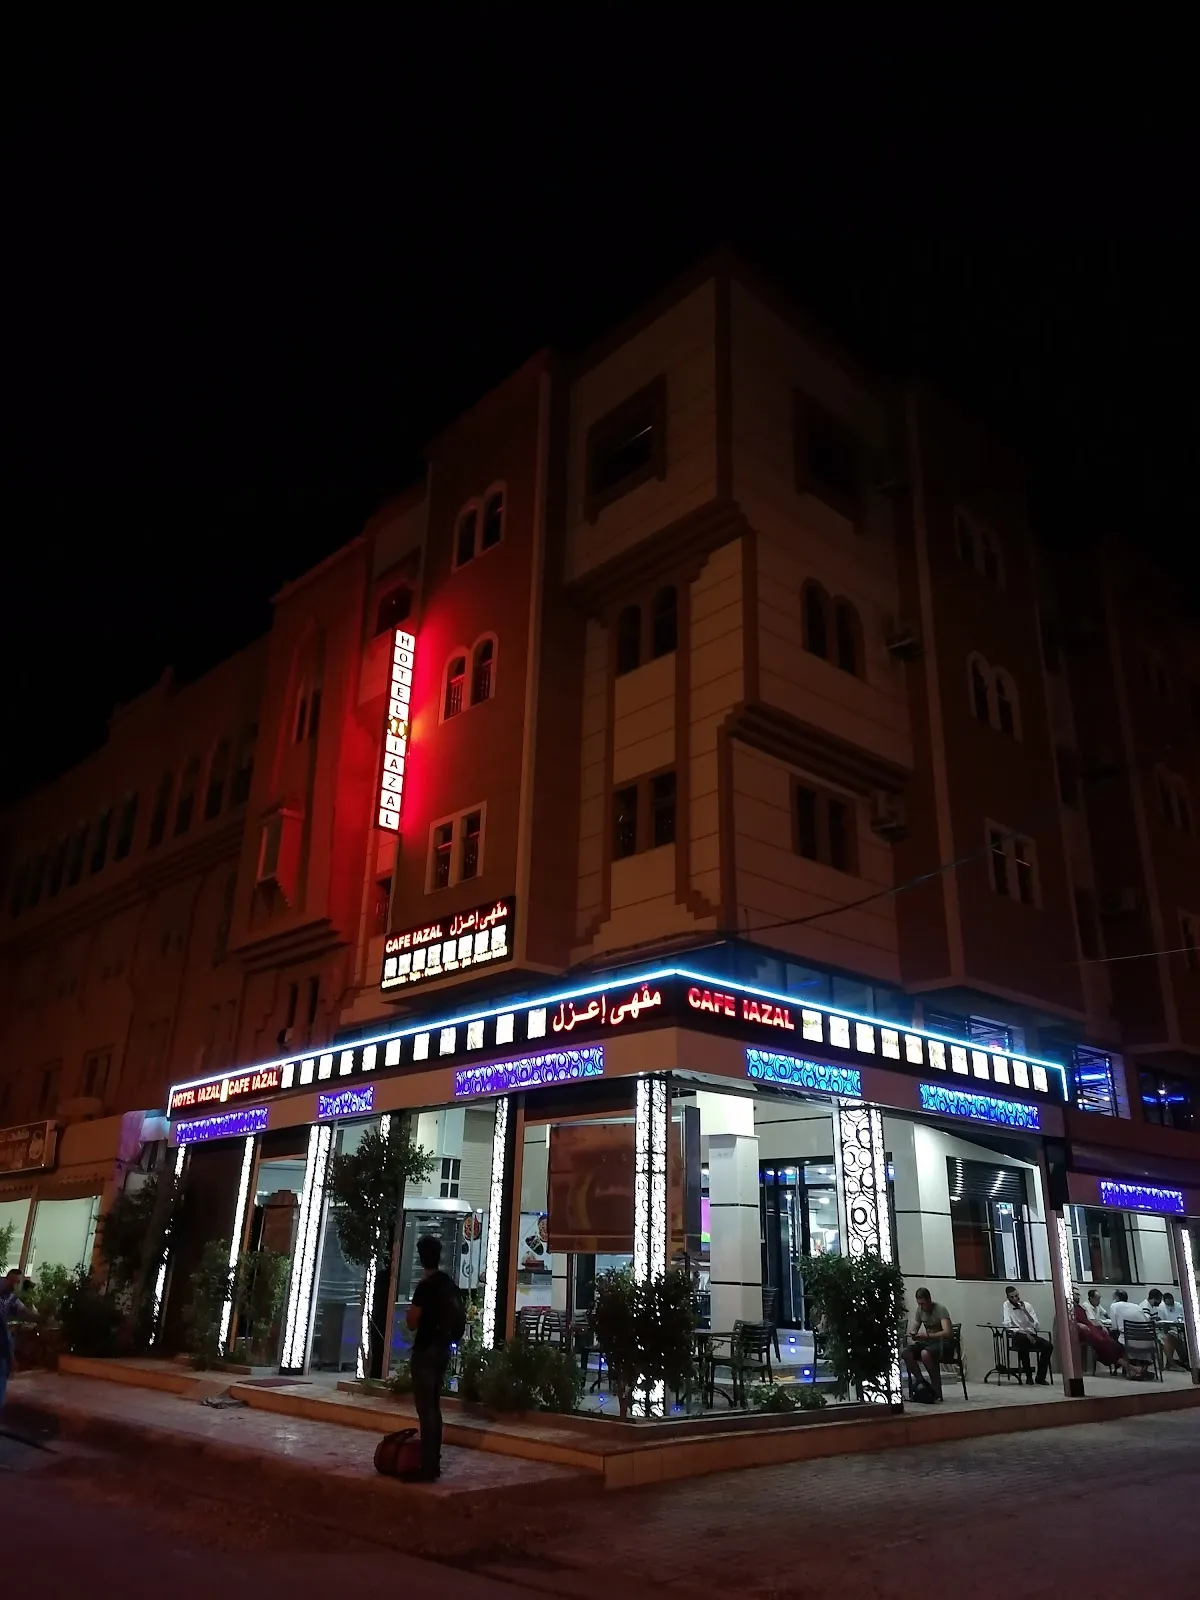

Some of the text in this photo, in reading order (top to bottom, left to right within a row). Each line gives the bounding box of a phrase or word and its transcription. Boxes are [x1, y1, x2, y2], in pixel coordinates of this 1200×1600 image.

[384, 634, 411, 827] HOTEL IAZAL
[479, 901, 508, 929] مقهى
[386, 924, 443, 953] CAFE IAZAL
[609, 983, 661, 1025] مقهى
[688, 987, 795, 1030] CAFE IAZAL
[172, 1084, 221, 1108] HOTEL IAZAL
[228, 1071, 279, 1095] CAFE IAZAL
